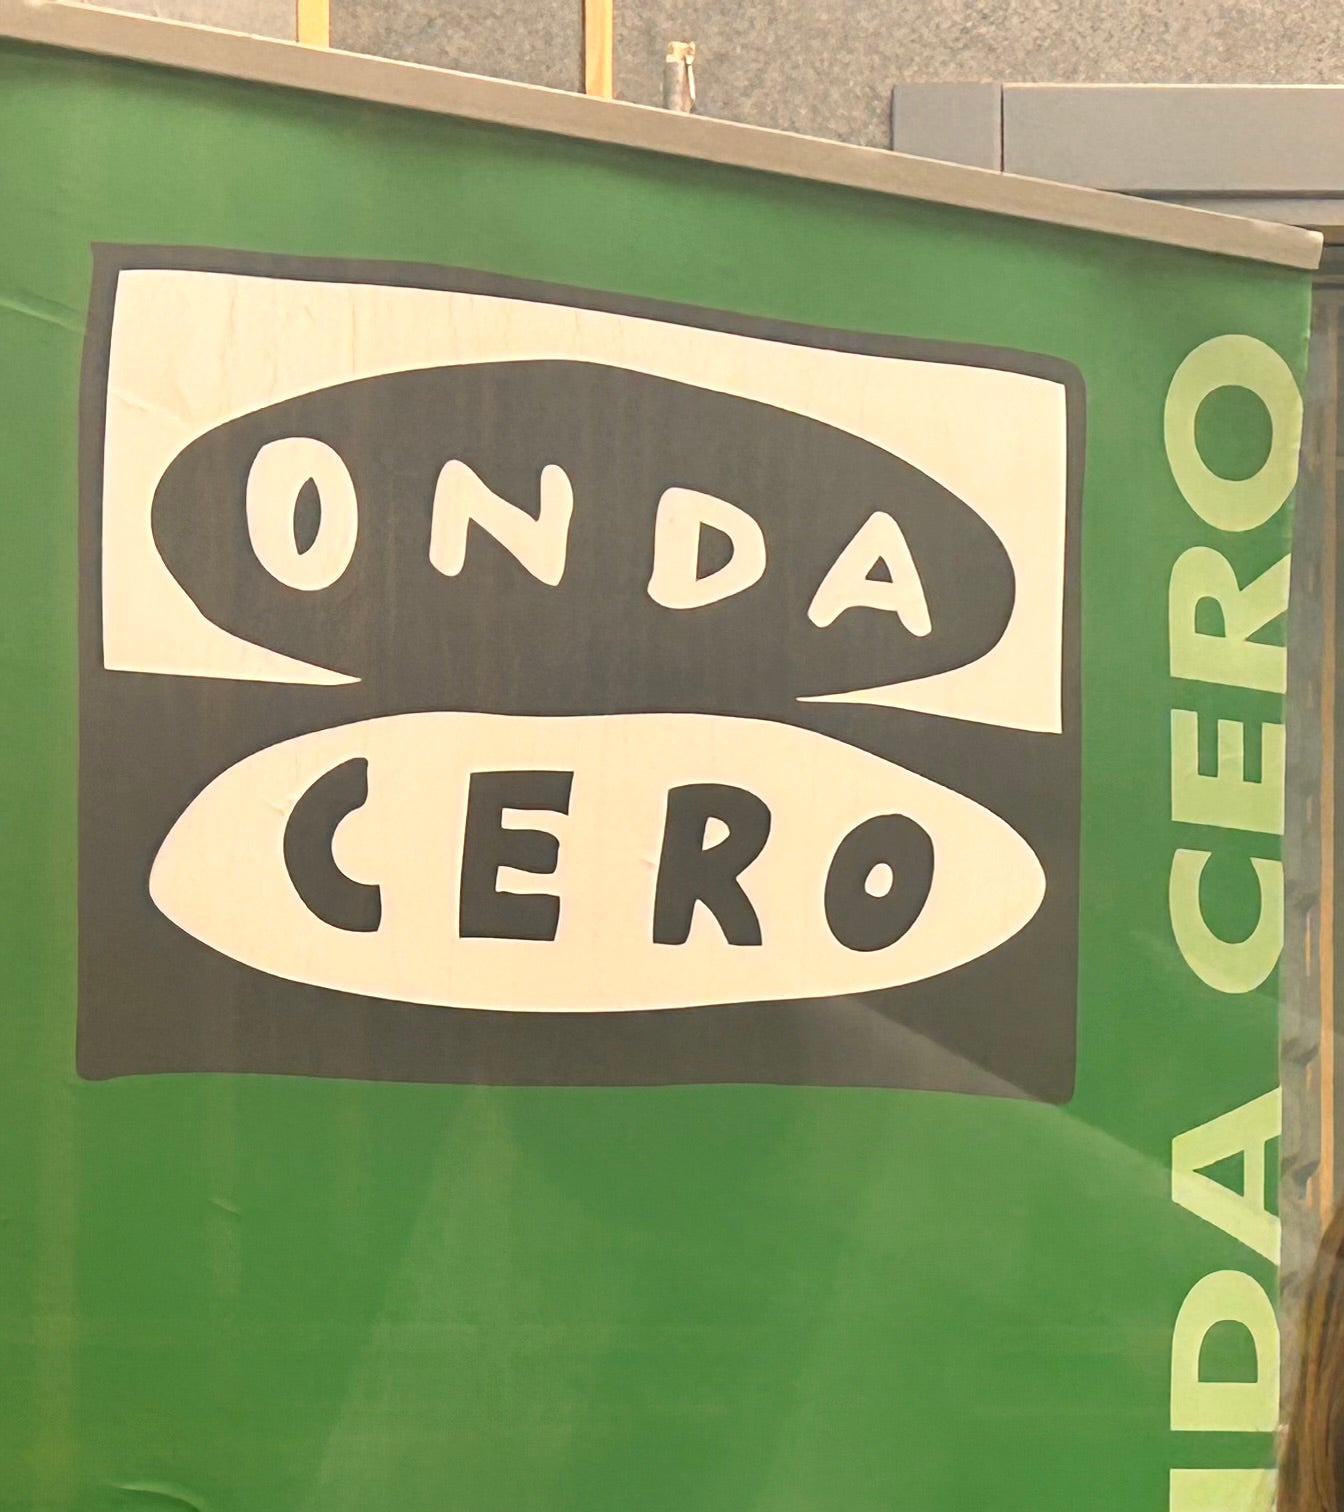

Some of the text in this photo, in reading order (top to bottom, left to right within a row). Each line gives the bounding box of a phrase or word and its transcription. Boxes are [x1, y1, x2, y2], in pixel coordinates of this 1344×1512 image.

[245, 436, 933, 637] ONDA
[1165, 333, 1305, 993] CERO
[282, 756, 936, 953] CERO
